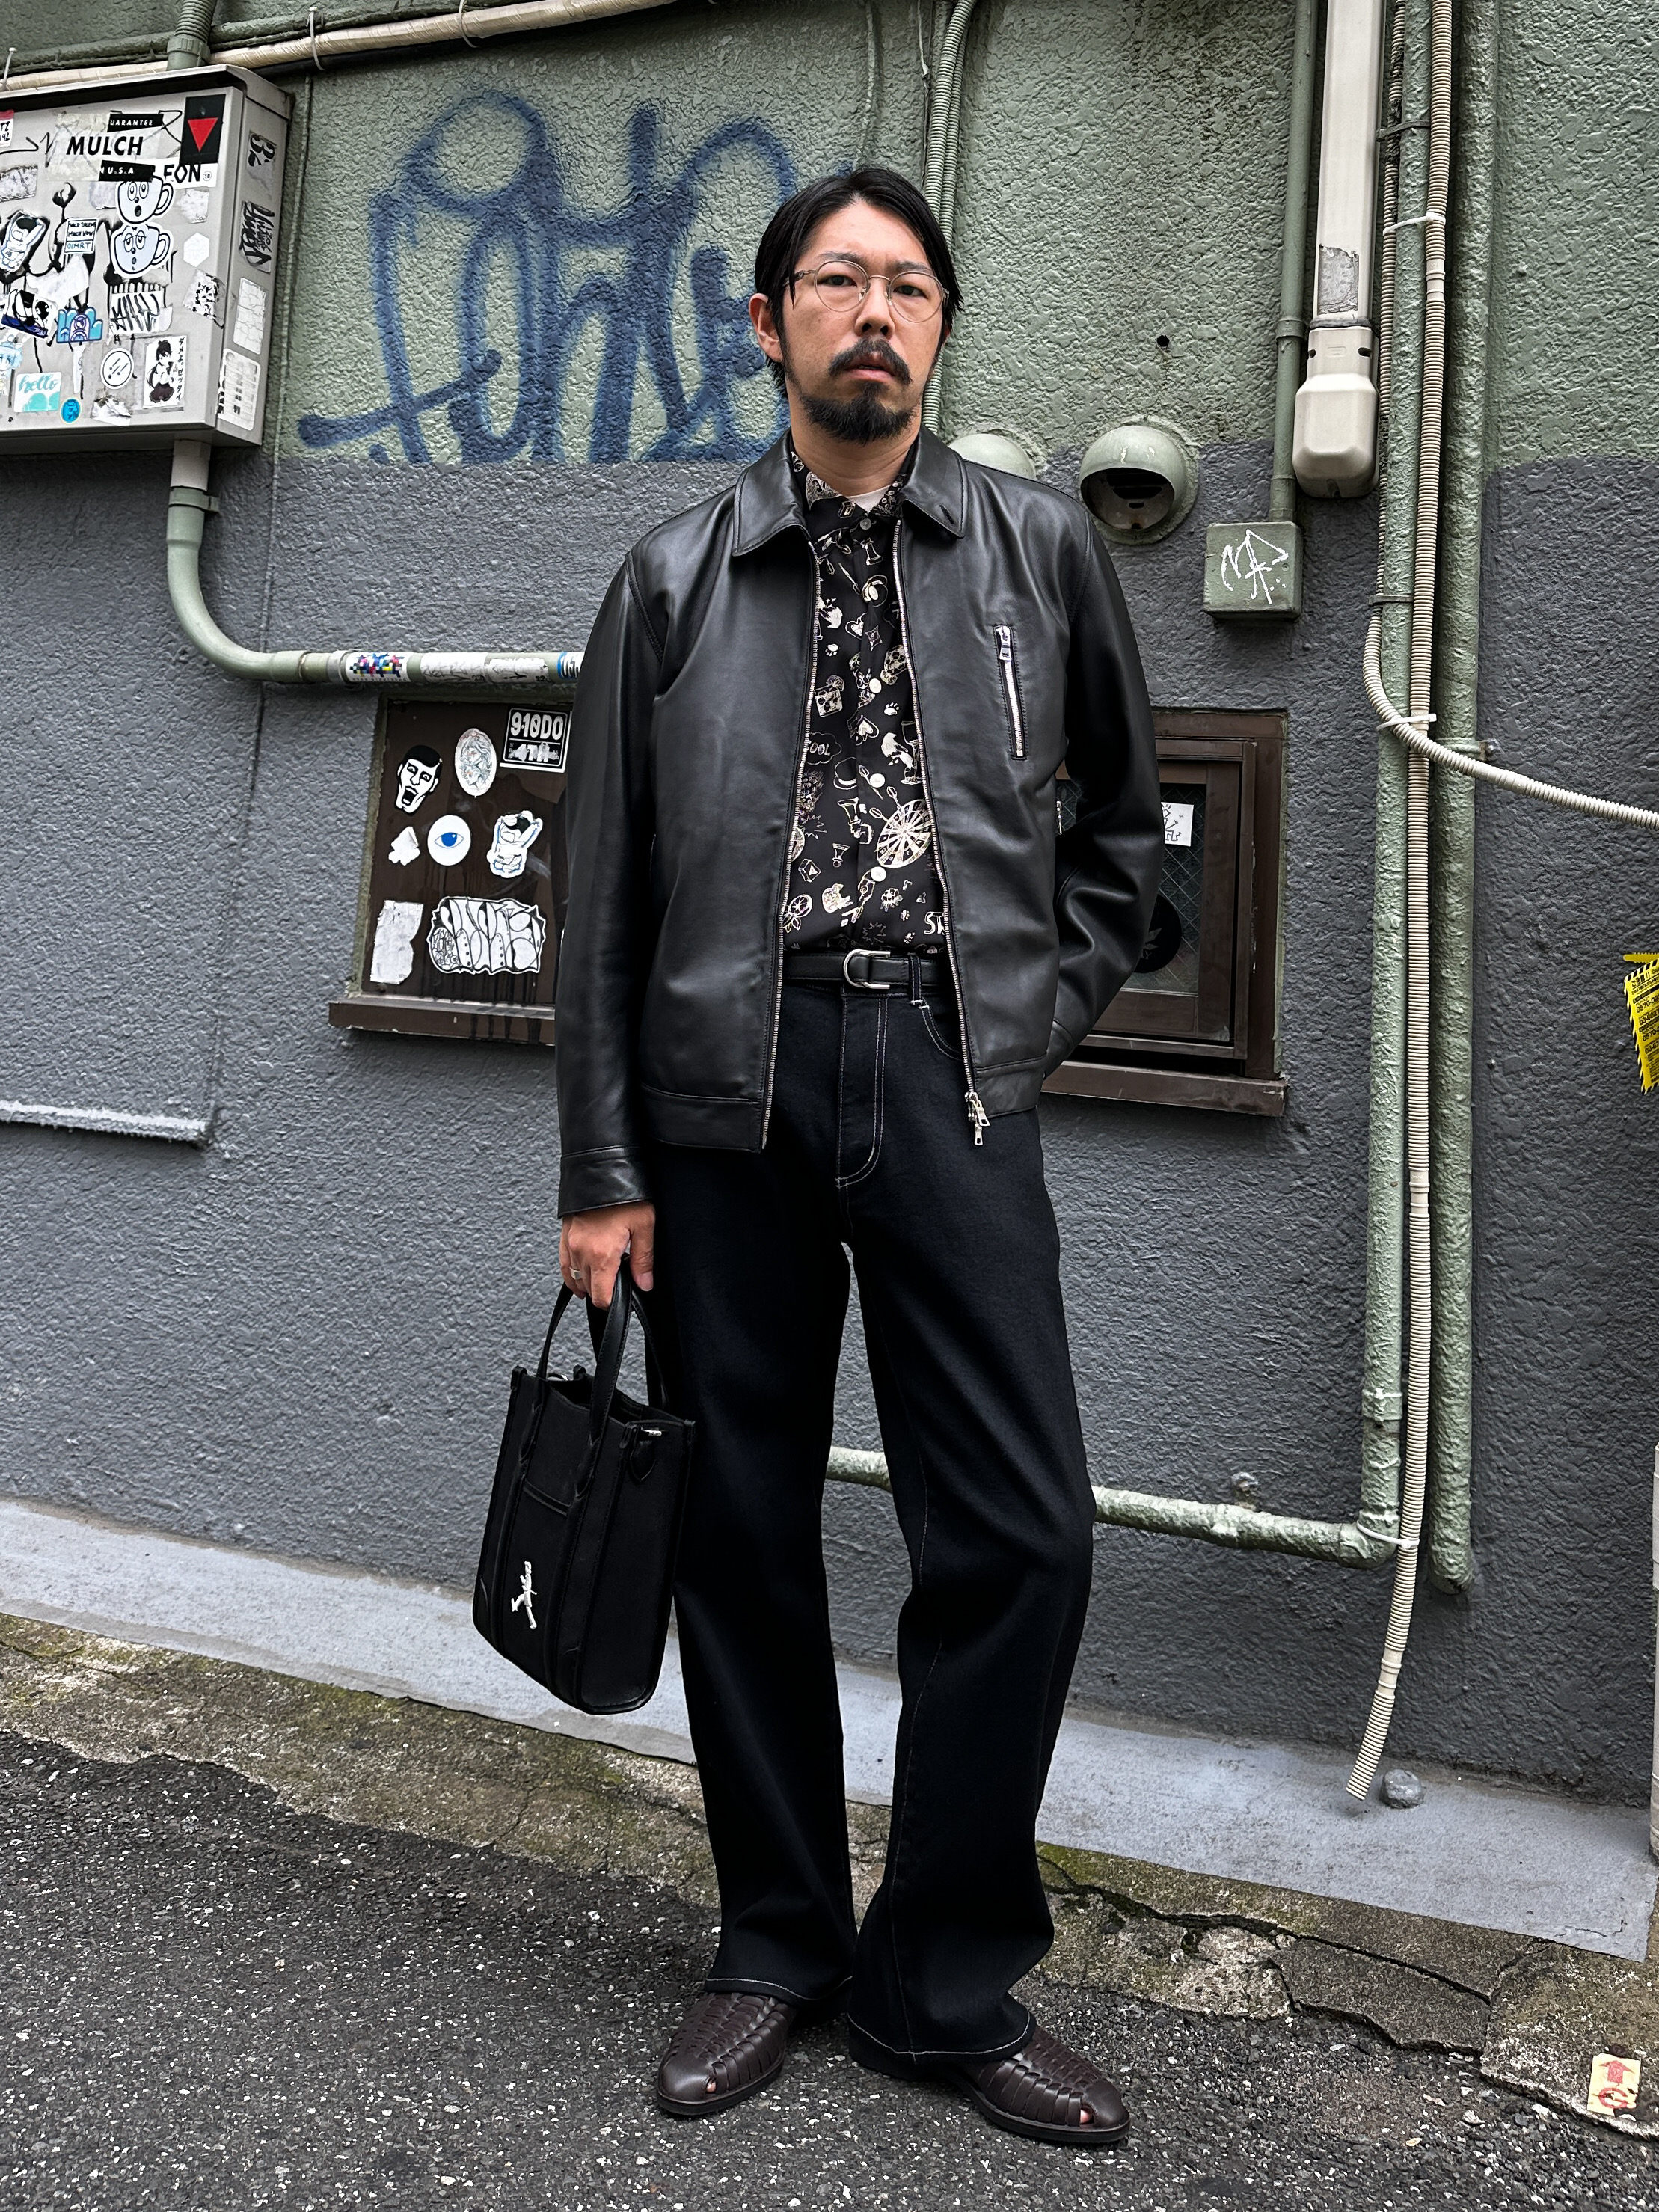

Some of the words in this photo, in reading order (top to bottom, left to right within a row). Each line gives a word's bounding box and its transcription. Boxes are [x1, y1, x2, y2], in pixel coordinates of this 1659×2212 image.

[66, 136, 144, 156] MULCH
[18, 374, 58, 393] hello
[808, 740, 831, 756] OOL
[924, 911, 947, 935] ST
